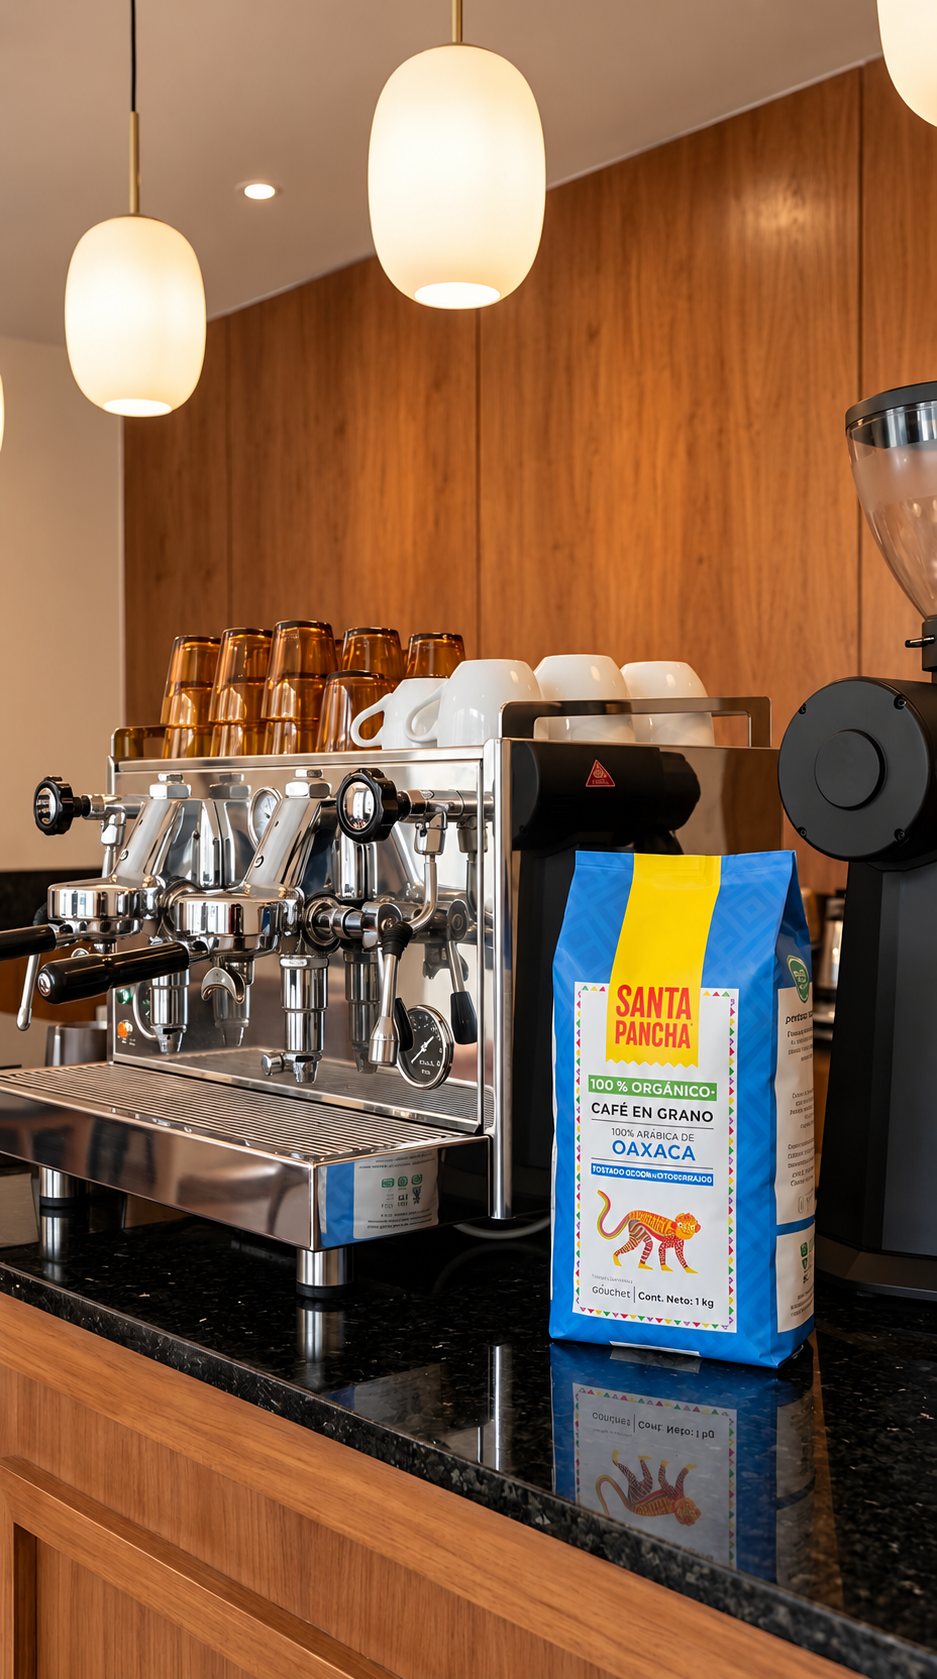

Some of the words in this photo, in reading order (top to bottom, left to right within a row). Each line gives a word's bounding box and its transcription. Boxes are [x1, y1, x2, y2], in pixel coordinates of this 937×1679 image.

[615, 984, 692, 1020] SANTA
[615, 1020, 691, 1049] PANCHA
[590, 1078, 614, 1091] 100
[616, 1080, 628, 1092] %
[591, 1102, 628, 1117] CAFÉ
[632, 1105, 652, 1119] EN
[657, 1107, 714, 1123] GRANO
[611, 1127, 635, 1138] 100%
[636, 1128, 679, 1141] ARÁBICA
[681, 1132, 695, 1142] DE
[612, 1140, 696, 1161] OAXACA
[638, 1291, 664, 1303] Cont.
[666, 1294, 693, 1306] Neto:
[695, 1297, 700, 1306] 1
[701, 1297, 714, 1310] kg
